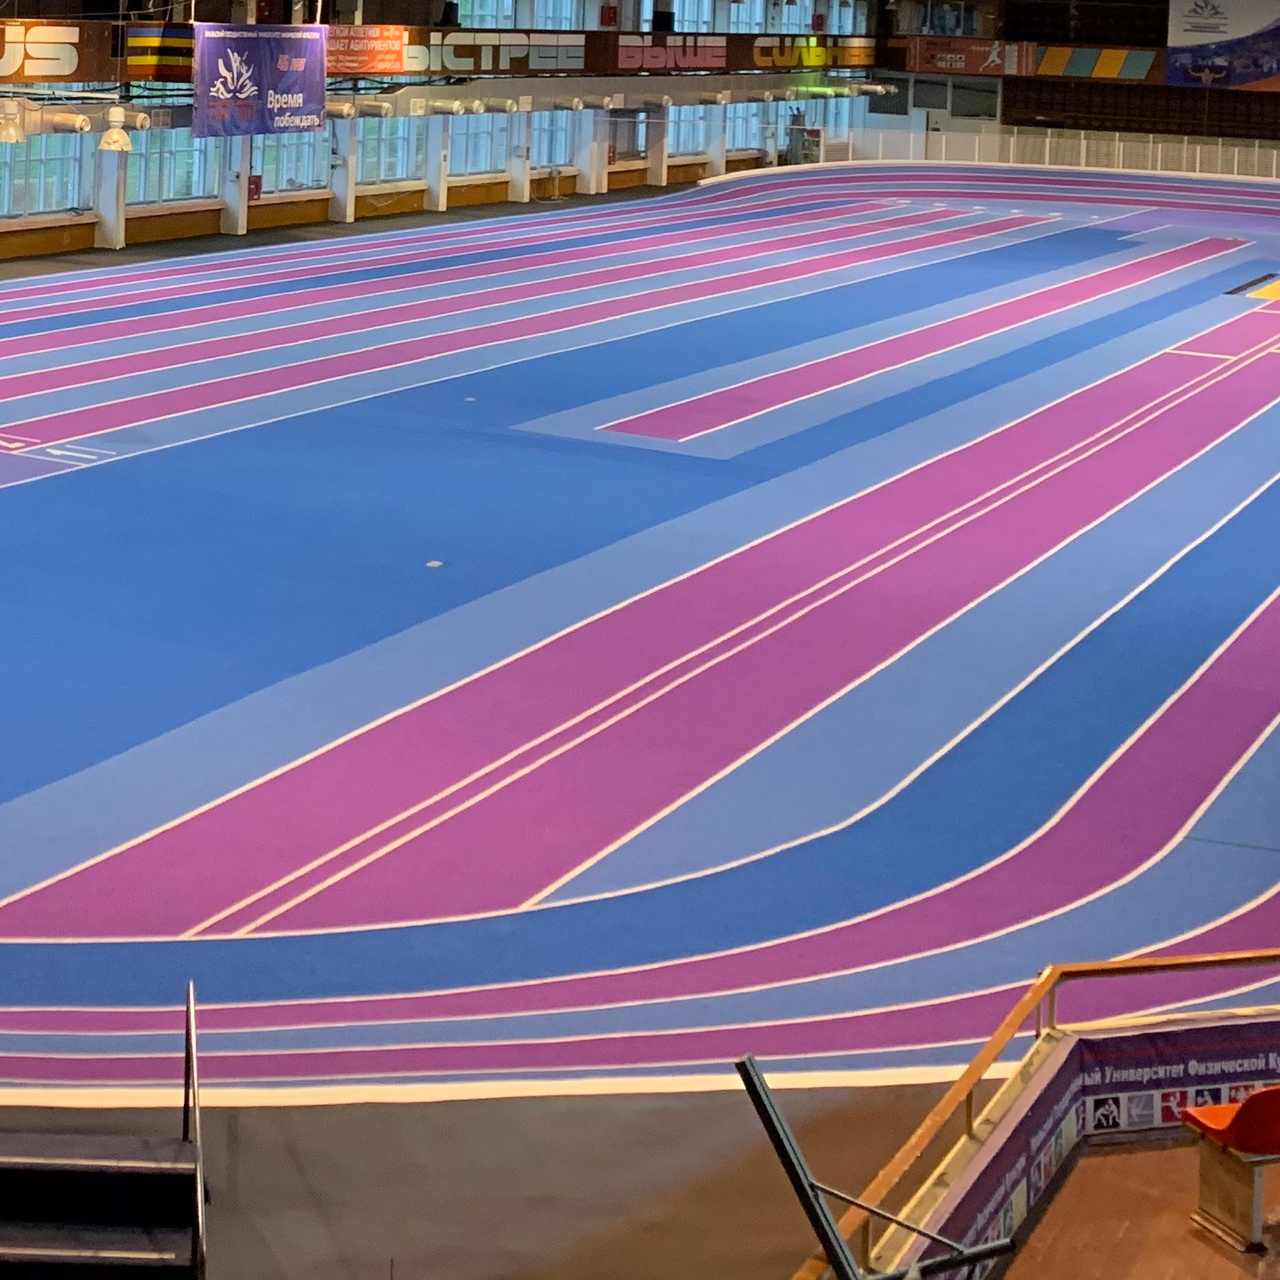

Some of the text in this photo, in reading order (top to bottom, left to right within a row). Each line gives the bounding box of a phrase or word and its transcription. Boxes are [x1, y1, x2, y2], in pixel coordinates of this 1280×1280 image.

[329, 26, 349, 38] ЕГКОЙ
[402, 31, 586, 71] ЫСТРЕЕ
[267, 90, 304, 113] Время
[46, 448, 98, 459] 1
[1104, 1063, 1185, 1085] Университет
[1187, 1053, 1266, 1076] Физической
